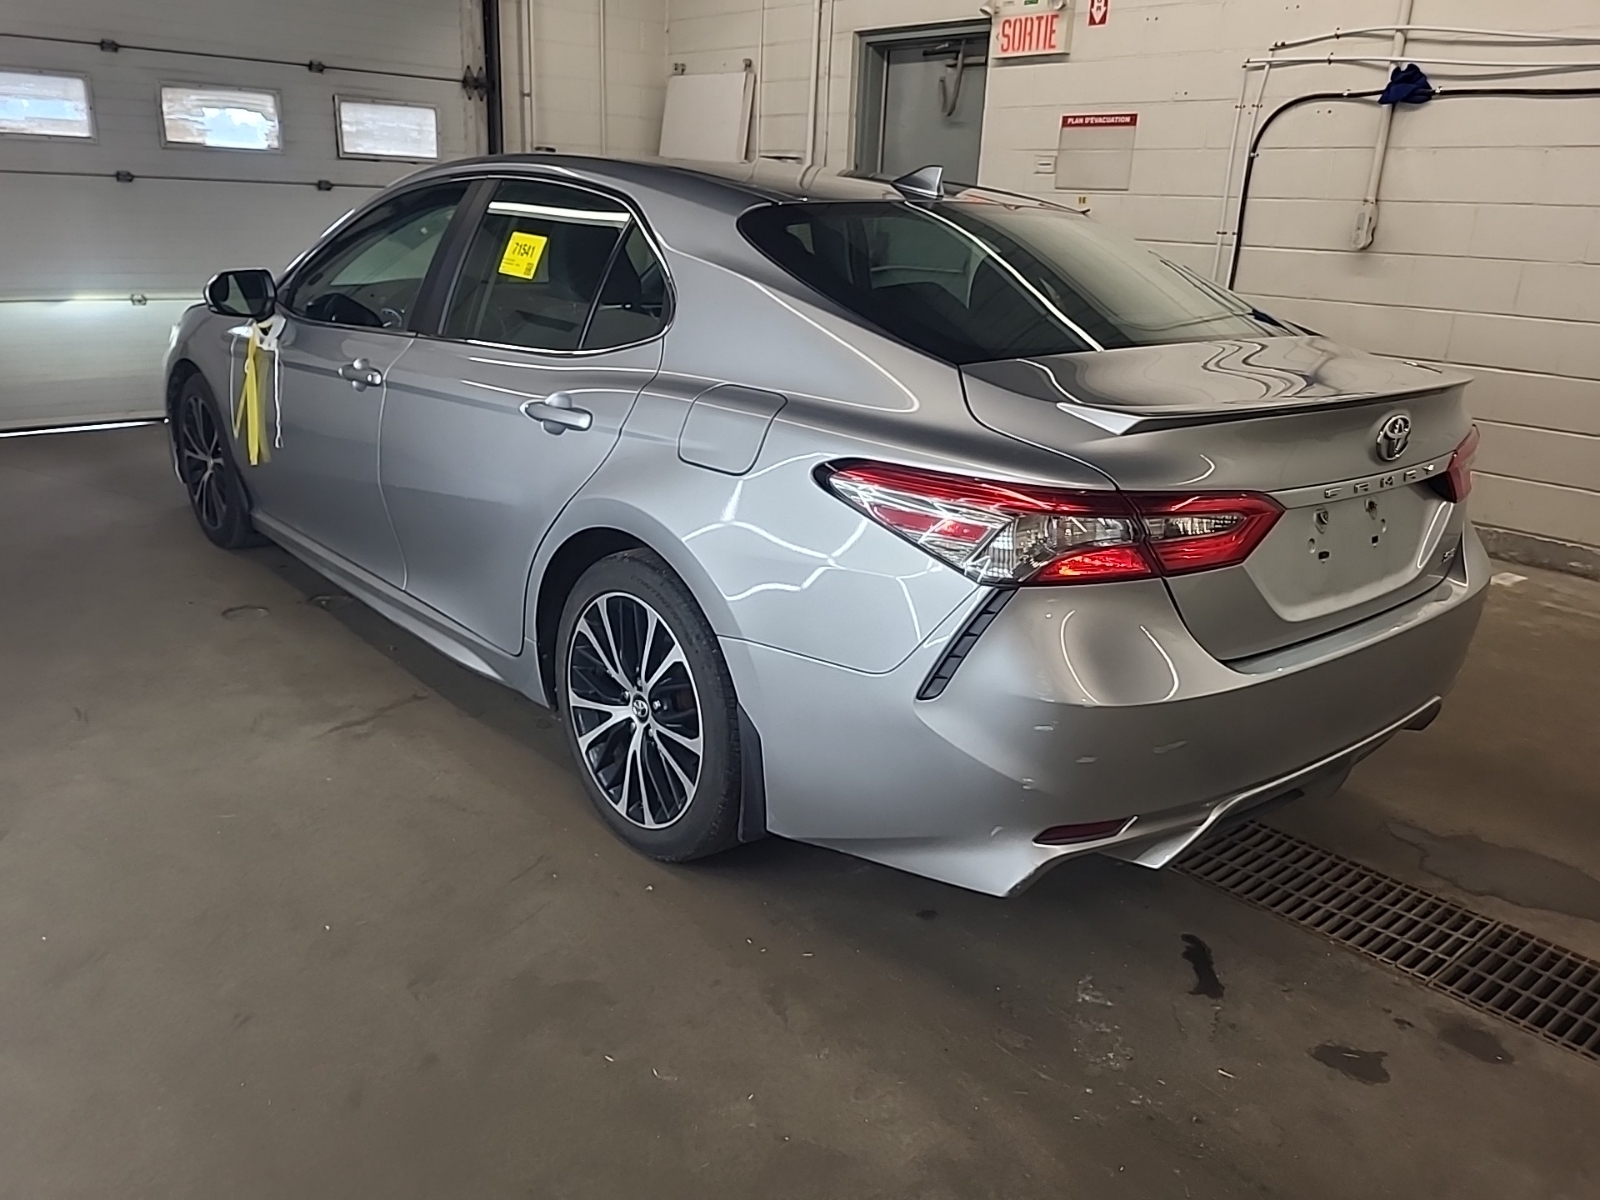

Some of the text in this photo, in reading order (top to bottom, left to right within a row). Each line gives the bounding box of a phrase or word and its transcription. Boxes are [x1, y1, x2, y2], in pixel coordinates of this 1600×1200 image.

[1001, 14, 1059, 52] SORTIE
[1067, 117, 1084, 125] PLAN
[512, 242, 536, 258] 71541
